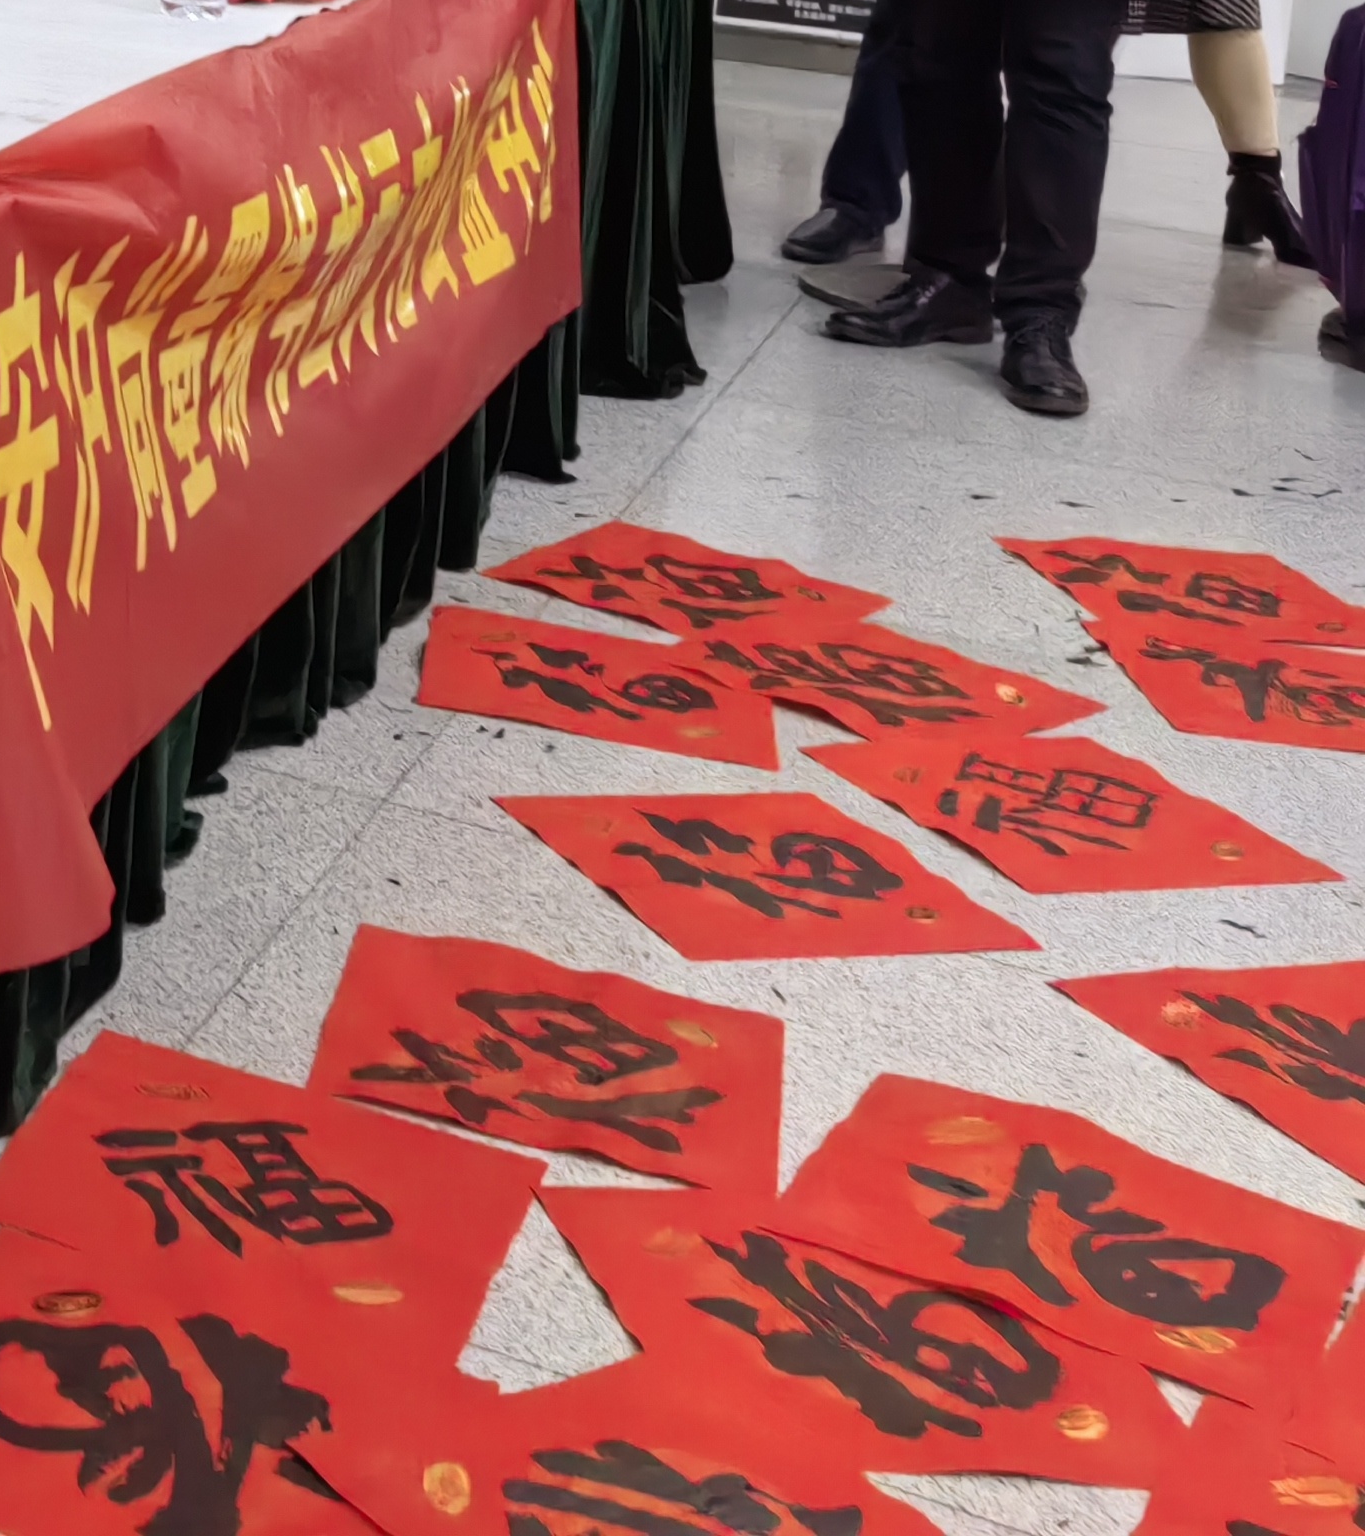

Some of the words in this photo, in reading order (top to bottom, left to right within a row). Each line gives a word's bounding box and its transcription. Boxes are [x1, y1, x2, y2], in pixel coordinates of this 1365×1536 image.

[535, 553, 787, 629] 福
[1041, 548, 1282, 627] 福
[469, 641, 718, 721] 福
[936, 751, 1162, 857] 福
[612, 807, 905, 921] 福
[350, 988, 728, 1155] 福
[94, 1119, 395, 1259] 福
